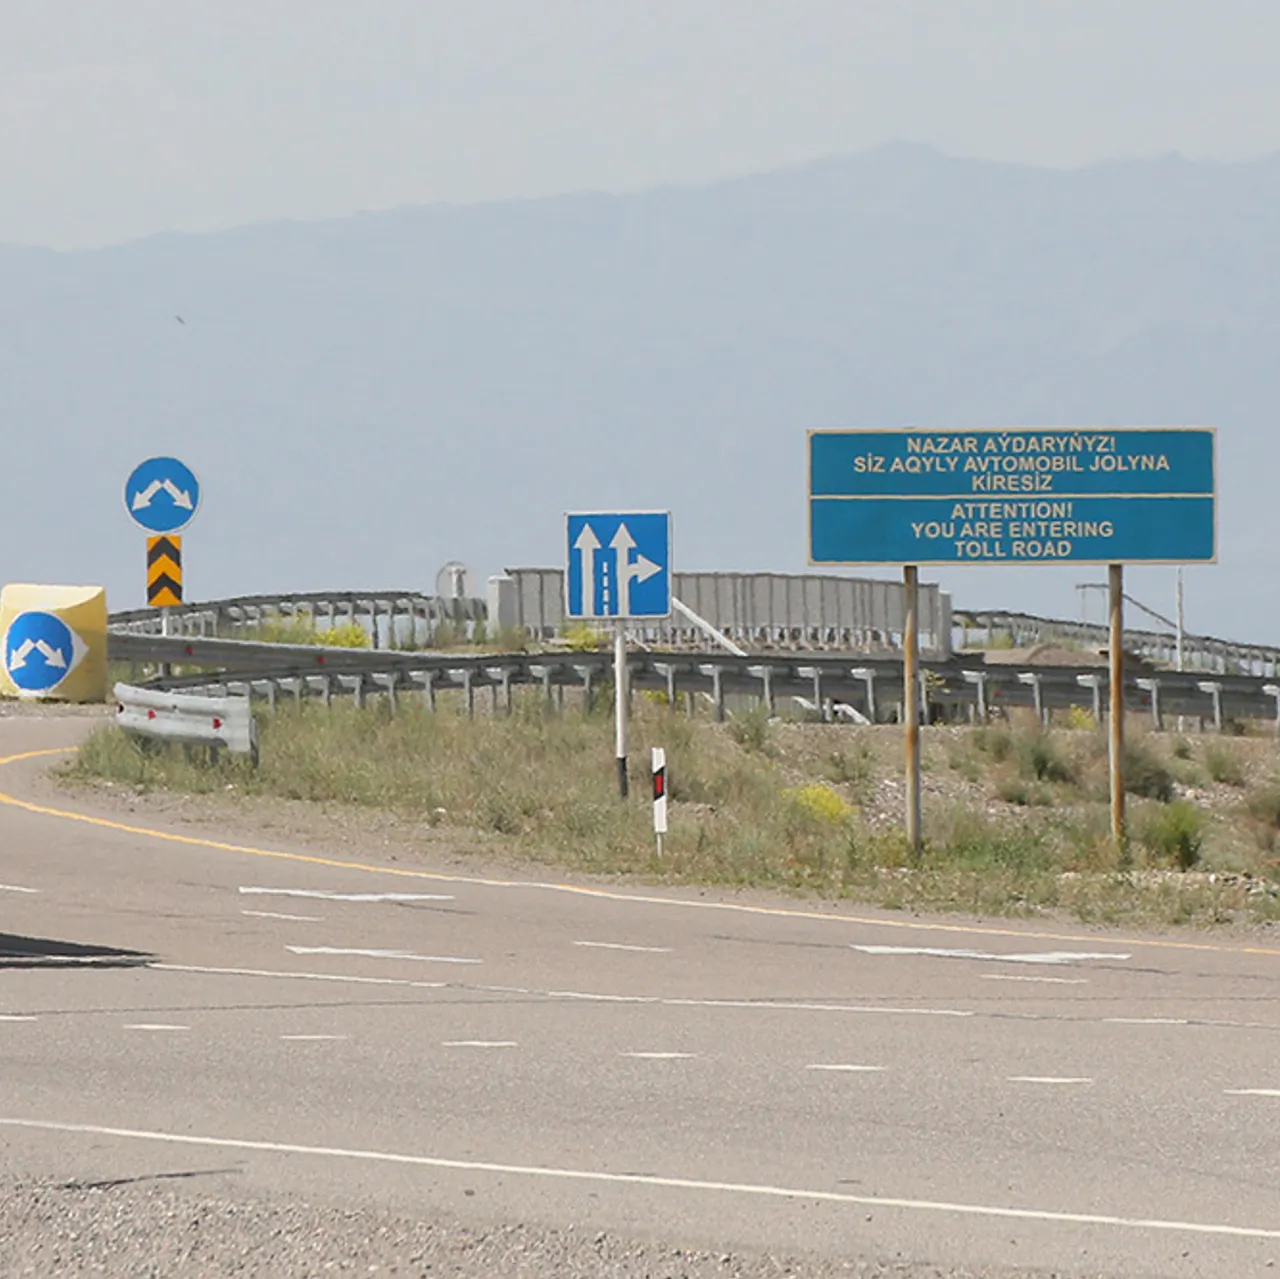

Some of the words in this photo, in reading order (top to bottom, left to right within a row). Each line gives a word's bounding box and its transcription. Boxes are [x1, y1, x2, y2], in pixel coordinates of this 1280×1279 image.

[907, 437, 978, 453] NAZAR
[889, 456, 959, 474] AQYLY
[964, 455, 1084, 473] AVTOMOBIL
[1089, 454, 1170, 471] JOLYNA
[951, 502, 1073, 519] ATTENTION!
[911, 522, 955, 539] YOU
[960, 522, 1003, 538] ARE
[1009, 521, 1114, 538] ENTERING
[954, 540, 1006, 557] TOLL
[1012, 540, 1072, 557] ROAD
